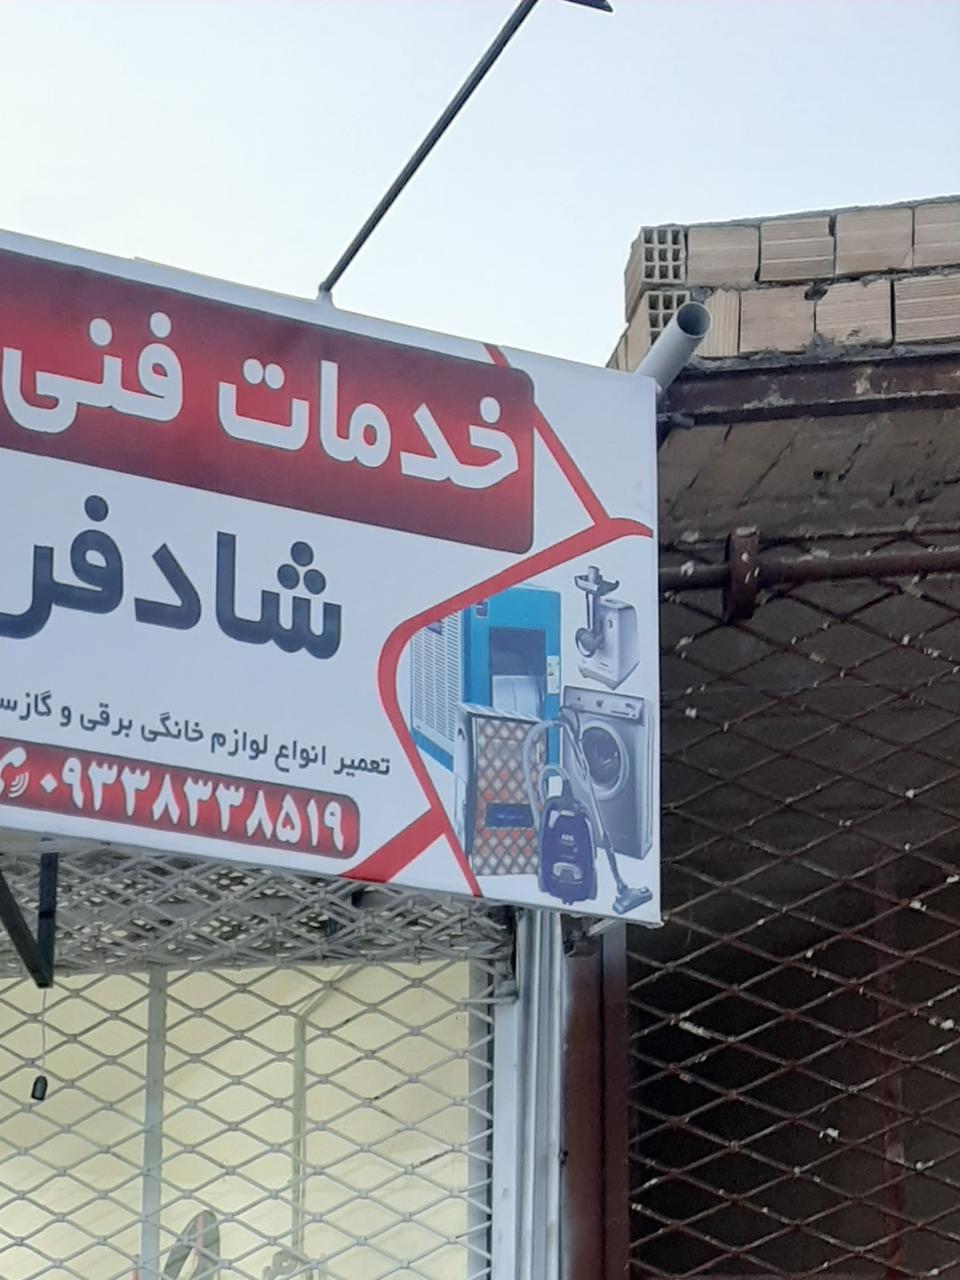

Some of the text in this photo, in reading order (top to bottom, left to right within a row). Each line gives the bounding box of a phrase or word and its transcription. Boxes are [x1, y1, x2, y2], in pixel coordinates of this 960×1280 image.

[0, 311, 520, 490] خدمات فنی
[59, 705, 73, 727] و
[79, 703, 133, 738] برقی
[141, 711, 205, 743] خانگی
[210, 729, 269, 760] لوازم
[274, 740, 327, 773] انواع
[333, 755, 391, 777] تعمیر
[39, 757, 344, 851] ۰۹۳۳۸۳۳۸۵۱۹
